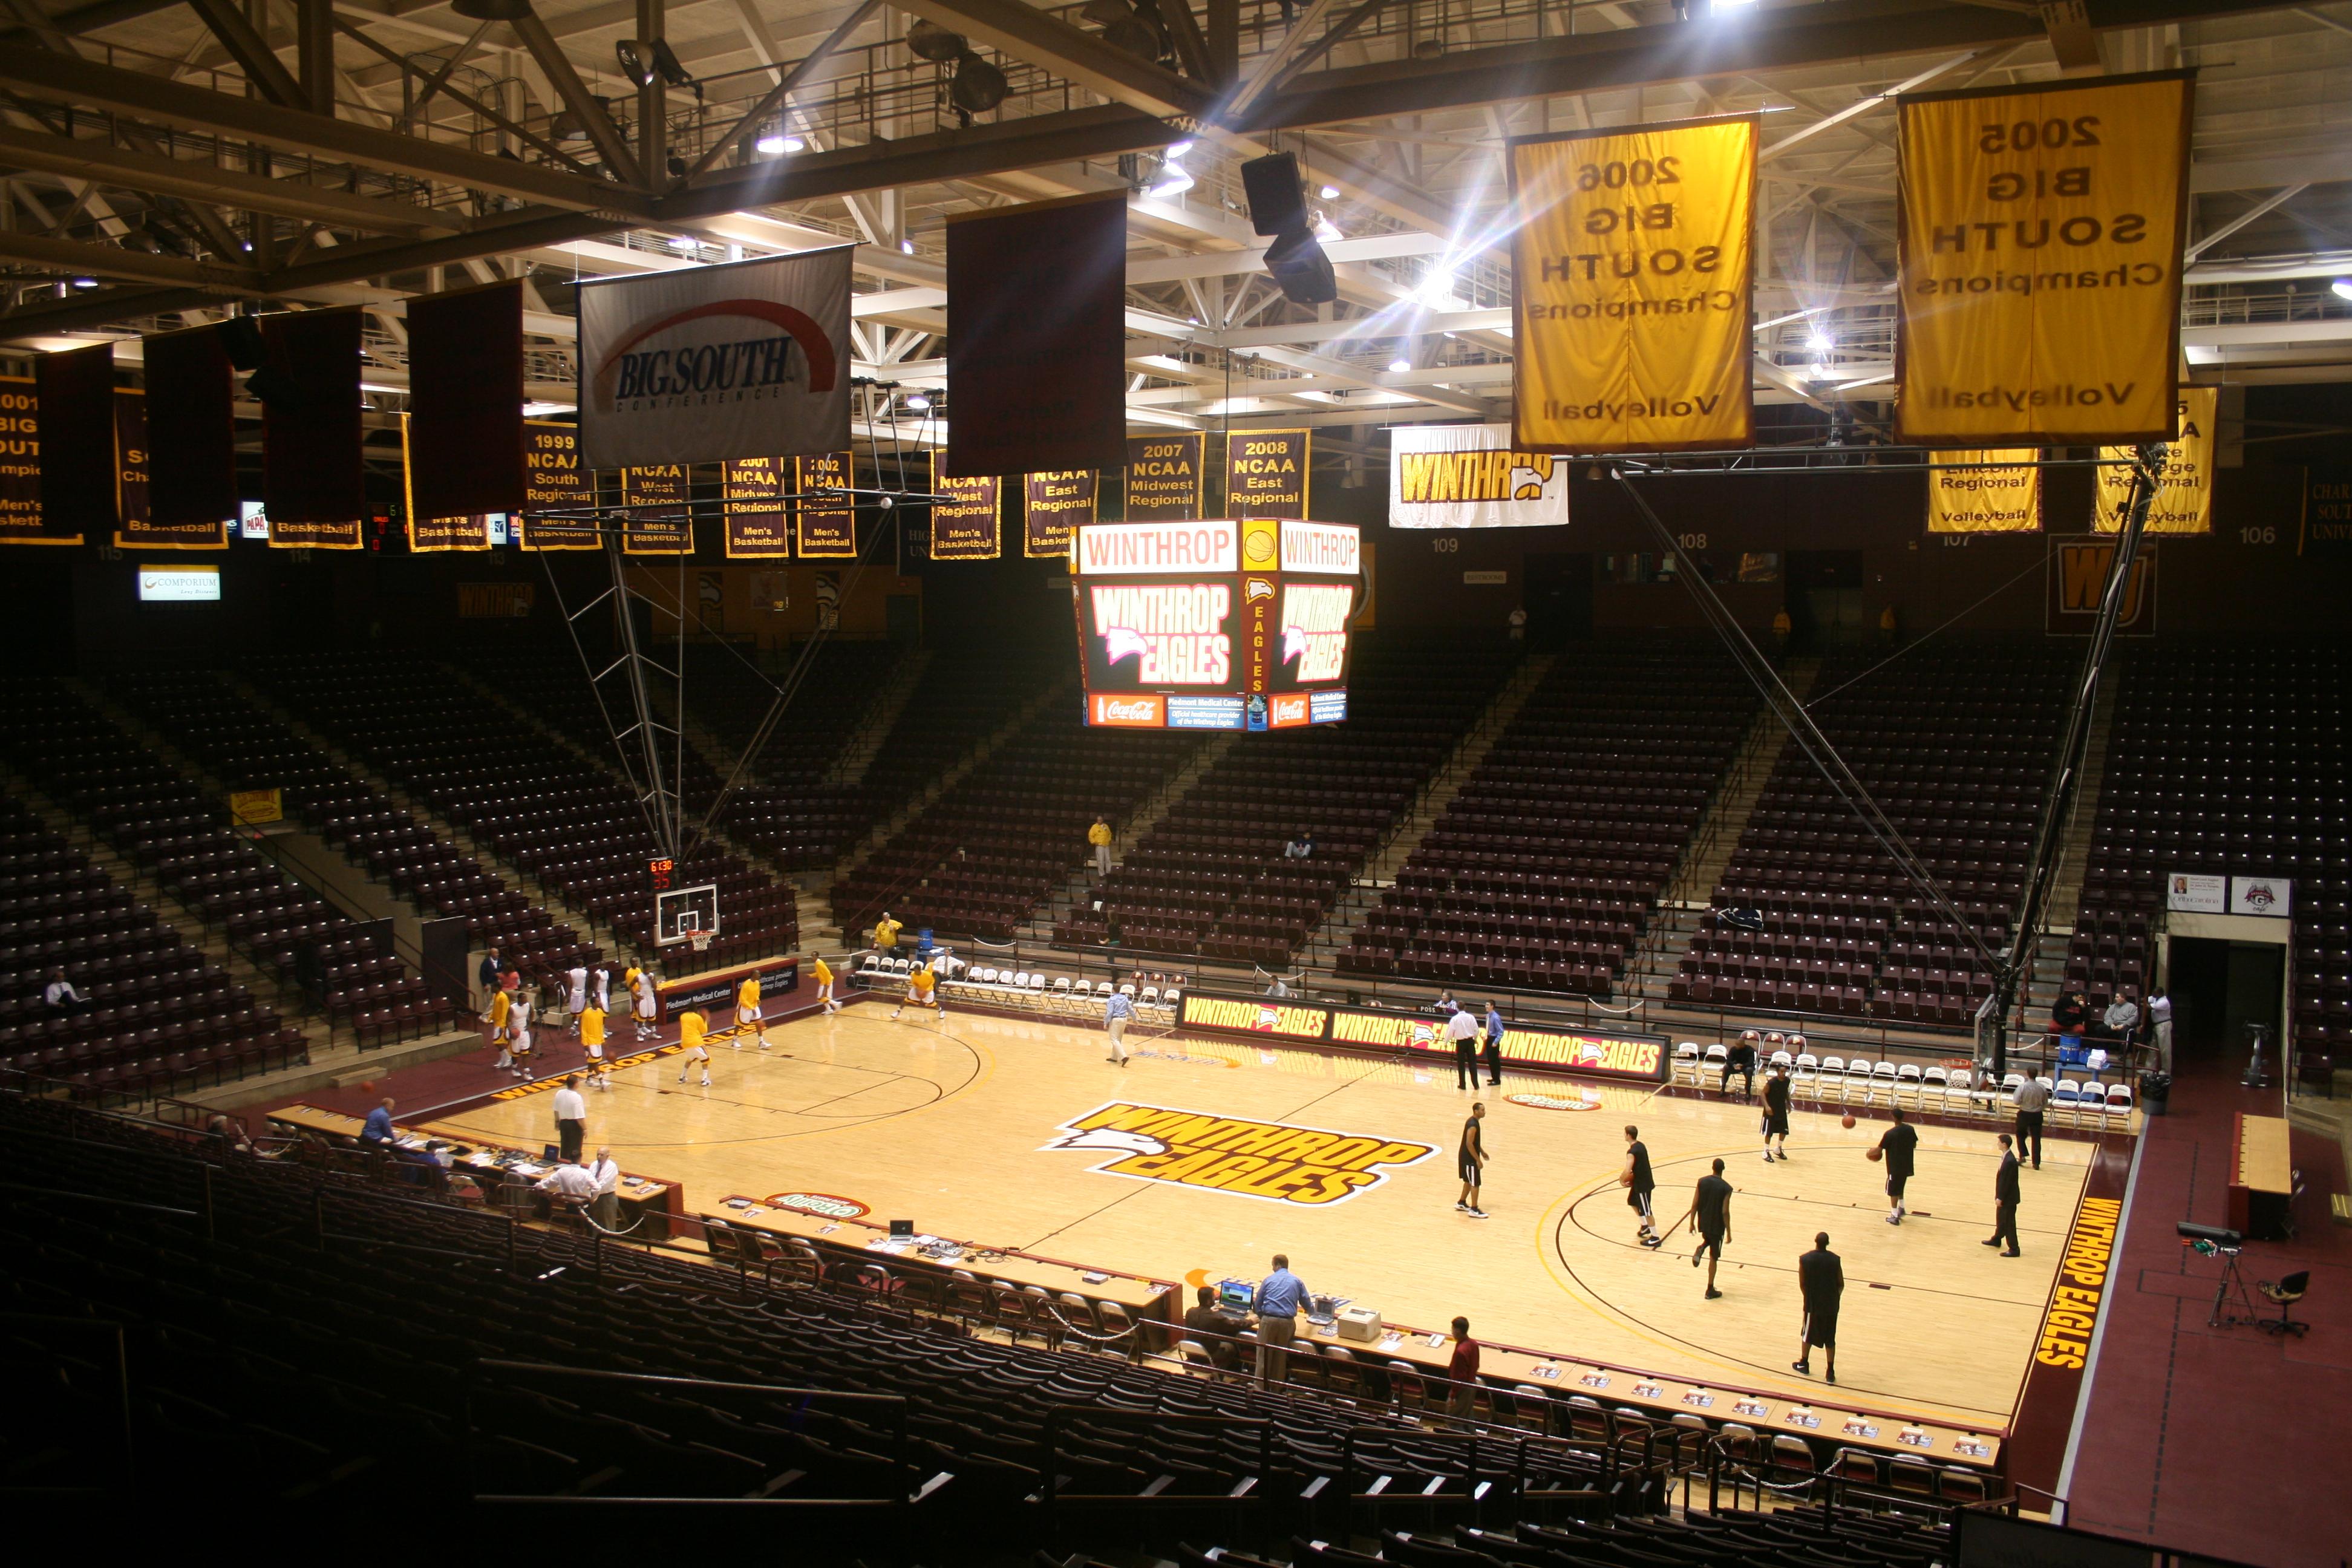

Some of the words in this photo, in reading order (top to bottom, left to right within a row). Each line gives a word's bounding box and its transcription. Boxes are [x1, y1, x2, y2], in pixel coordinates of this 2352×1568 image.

[615, 350, 670, 399] BIG
[671, 336, 792, 394] SOUTH
[0, 394, 38, 411] 001
[616, 389, 779, 413] CONFERENCE
[535, 434, 575, 449] 1999
[1245, 441, 1288, 456] 2008
[1143, 444, 1184, 458] 2007
[632, 464, 682, 477] NCAA
[1134, 461, 1191, 476] NCAA
[1234, 459, 1296, 474] NCAA
[535, 473, 579, 485] South
[732, 471, 778, 485] NCAA
[939, 475, 991, 489] NCAA
[1033, 470, 1089, 483] NCAA
[1247, 477, 1283, 489] East
[2108, 477, 2199, 487] Reonal
[1045, 484, 1078, 497] East
[1130, 479, 1194, 491] Midwest
[1940, 477, 2025, 491] Regional
[731, 489, 777, 498] Midwes
[1230, 491, 1299, 506] Regional
[732, 503, 782, 513] Regional
[1030, 497, 1091, 513] Regional
[1129, 494, 1194, 508] Regional
[936, 503, 993, 518] Regional
[1940, 510, 2026, 523] Volleyball
[2108, 512, 2198, 523] Veyball
[246, 516, 265, 530] PAPA
[278, 523, 353, 534] Basketball
[419, 527, 483, 538] Basketball
[744, 527, 773, 535] Men's
[814, 528, 840, 537] Men's
[949, 529, 981, 538] Men's
[2239, 526, 2276, 544] 106
[734, 537, 783, 546] Basketball
[805, 538, 849, 547] Basketball
[938, 540, 992, 549] Basketball
[1087, 529, 1230, 566] WINTHROP
[1285, 529, 1356, 566] WINTHROP
[1432, 538, 1459, 552] 109
[1677, 534, 1707, 549] 108
[157, 578, 217, 587] COMPORIUM
[1091, 584, 1229, 635] WINTHROP
[1281, 584, 1353, 635] WINTHROP
[1253, 606, 1264, 691] EAGLES
[1140, 635, 1230, 684] EAGLES
[1298, 633, 1346, 682] EAGLES
[1168, 697, 1197, 707] Piedmont
[1198, 698, 1221, 707] Medical
[1222, 699, 1244, 707] Center
[1193, 718, 1217, 727] Winthrop
[1217, 718, 1235, 727] Eagles
[774, 971, 792, 981] provider
[774, 979, 789, 988] Eagles
[666, 998, 691, 1010] Piedmont
[692, 991, 714, 1002] Medical
[714, 988, 731, 998] Center
[1184, 997, 1261, 1030] WINTHROP
[1272, 1006, 1327, 1039] EAGLES
[1332, 1012, 1416, 1047] WINTHROP
[659, 1024, 756, 1055] EGLES
[1499, 1031, 1583, 1065] WINTHROP
[1596, 1040, 1660, 1074] EAGLES
[1071, 1103, 1434, 1172] WINTHROP
[1097, 1145, 1382, 1204] EAGLES
[2063, 1197, 2122, 1286] WINTHROP
[2036, 1285, 2100, 1369] EAGLES
